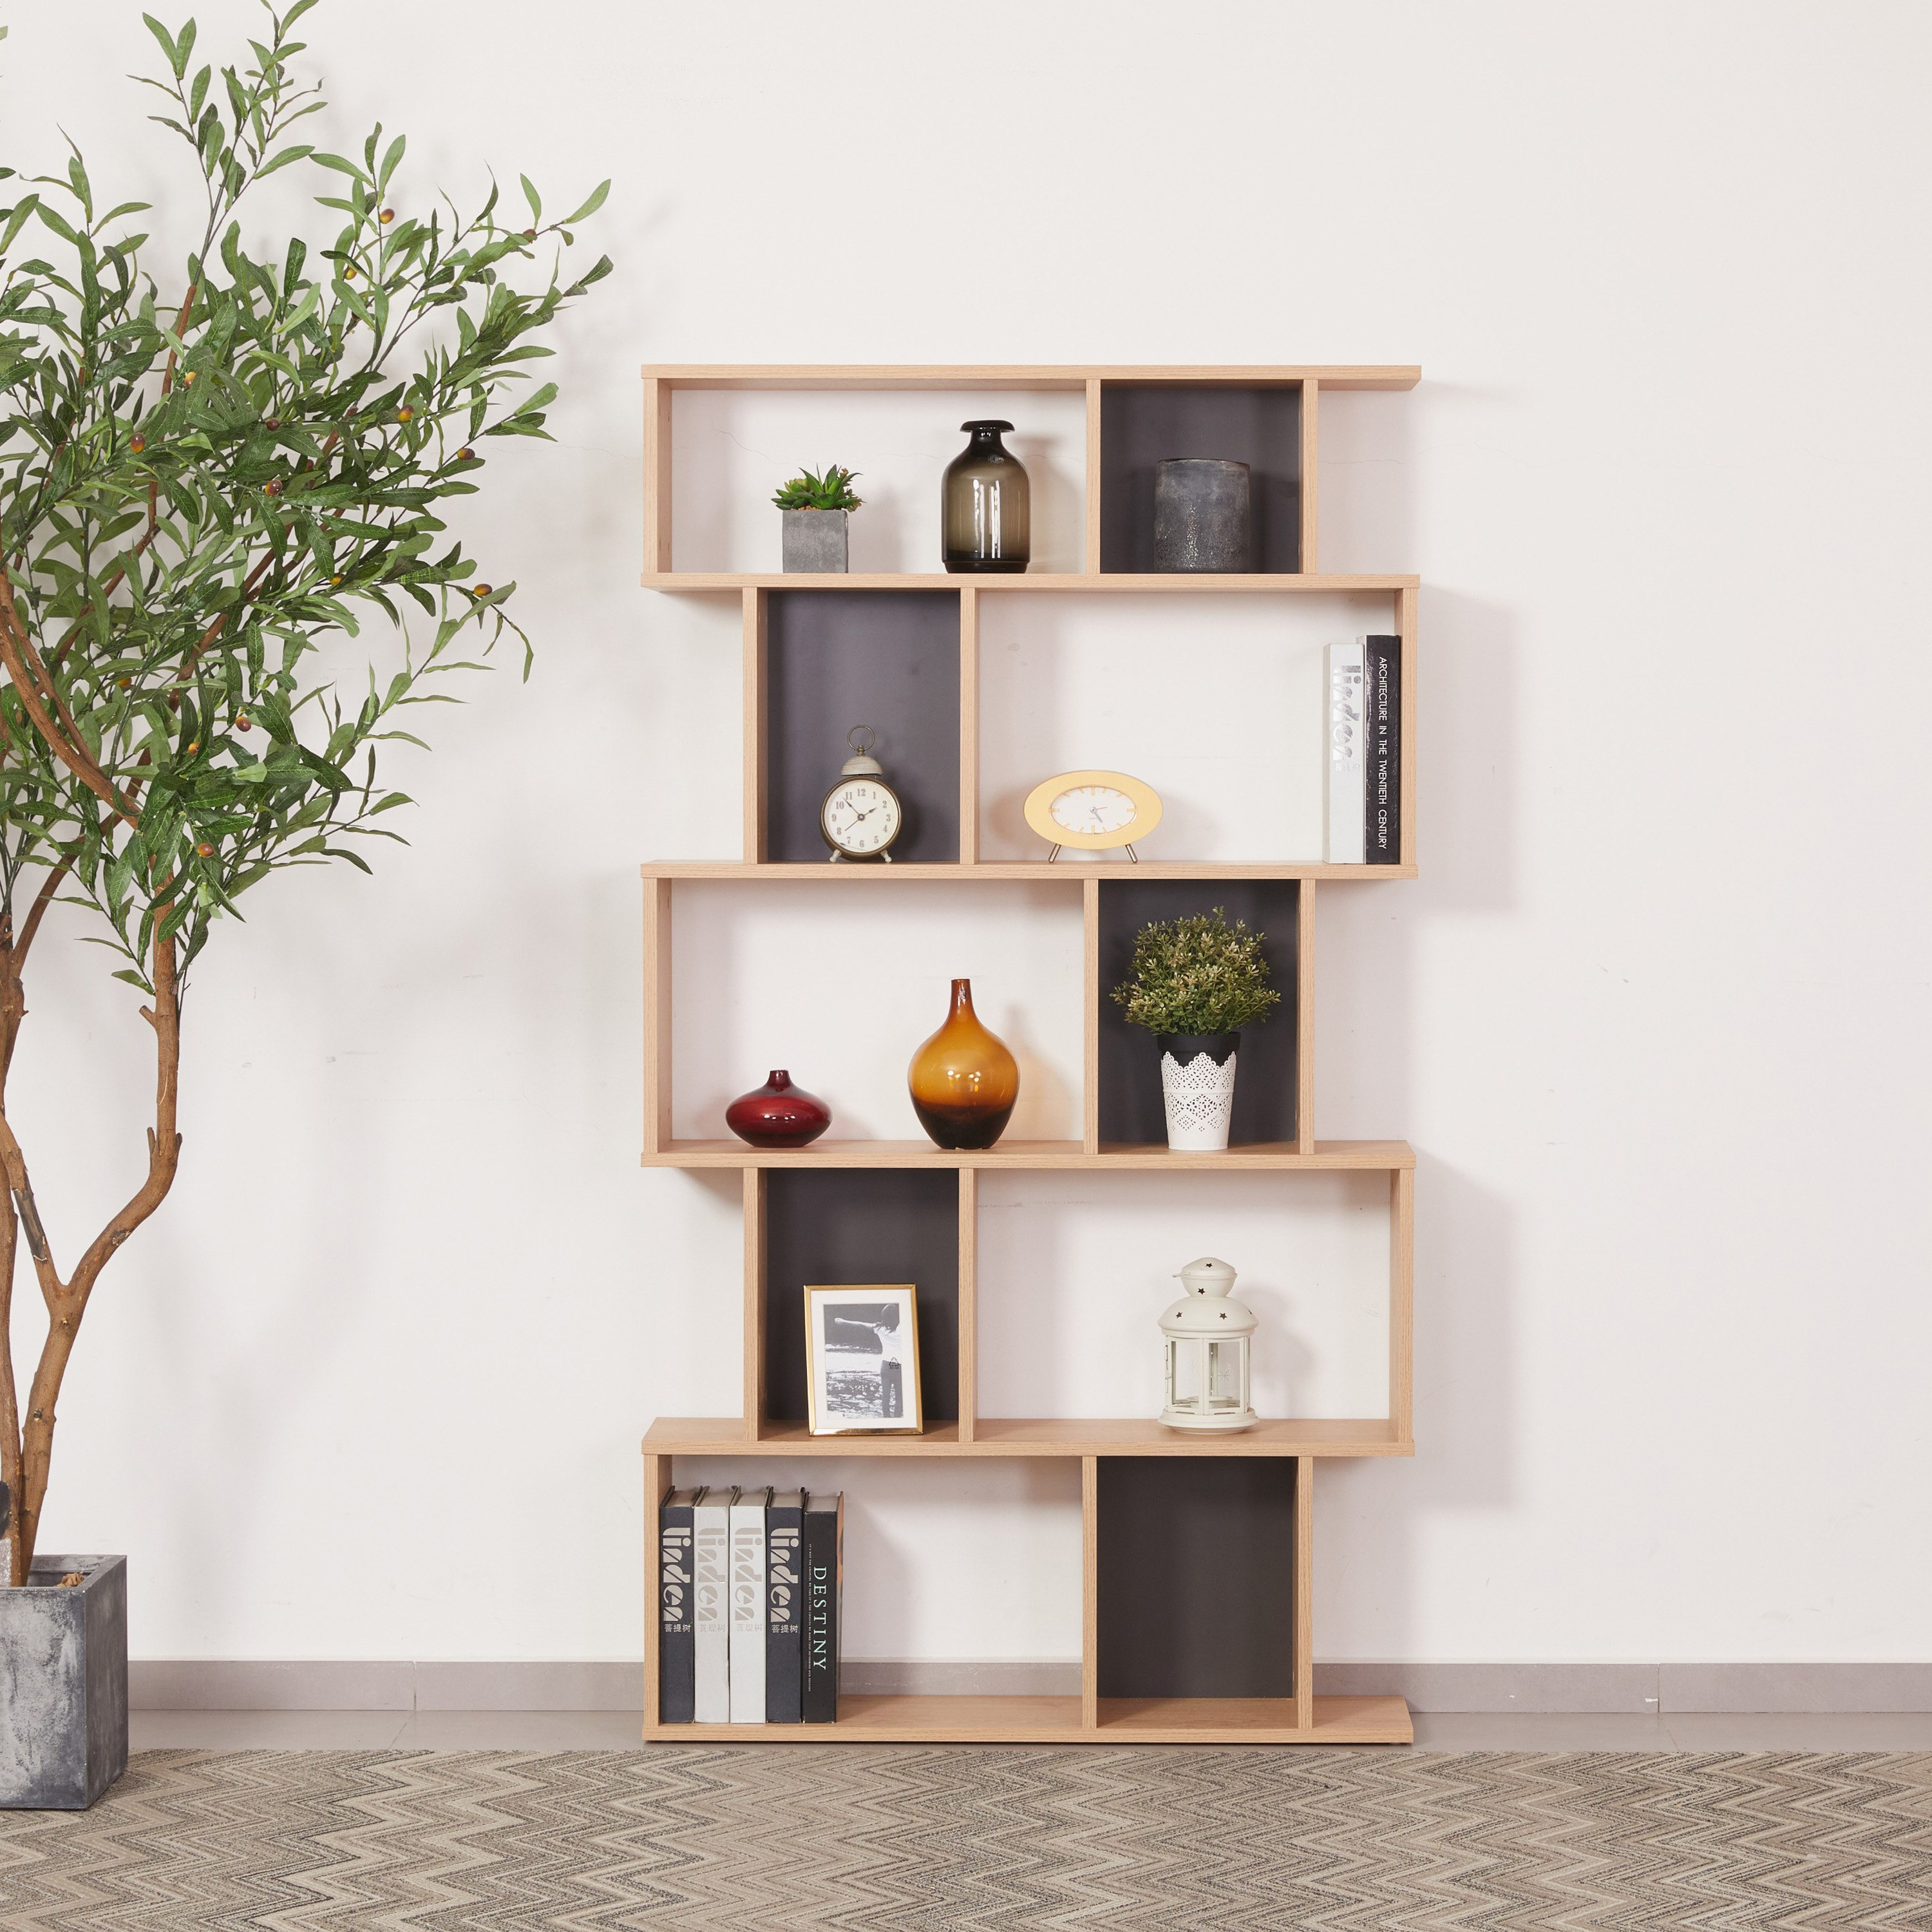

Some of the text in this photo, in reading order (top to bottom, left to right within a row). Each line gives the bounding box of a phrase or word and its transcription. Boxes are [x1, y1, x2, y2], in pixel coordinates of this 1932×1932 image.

[1332, 665, 1361, 761] linden
[1378, 656, 1387, 849] ARCHITECTURE IN THE TWENTIETH CENTURY
[831, 813, 837, 822] 9
[836, 801, 844, 810] 10
[837, 827, 842, 835] 8
[886, 813, 891, 822] 3
[663, 1527, 691, 1622] linden
[697, 1527, 726, 1622] linden
[735, 1527, 762, 1622] linden
[770, 1528, 799, 1622] linden
[813, 1566, 827, 1670] DESTINY
[664, 1624, 691, 1633] 菩提树
[772, 1624, 798, 1633] 菩提树
